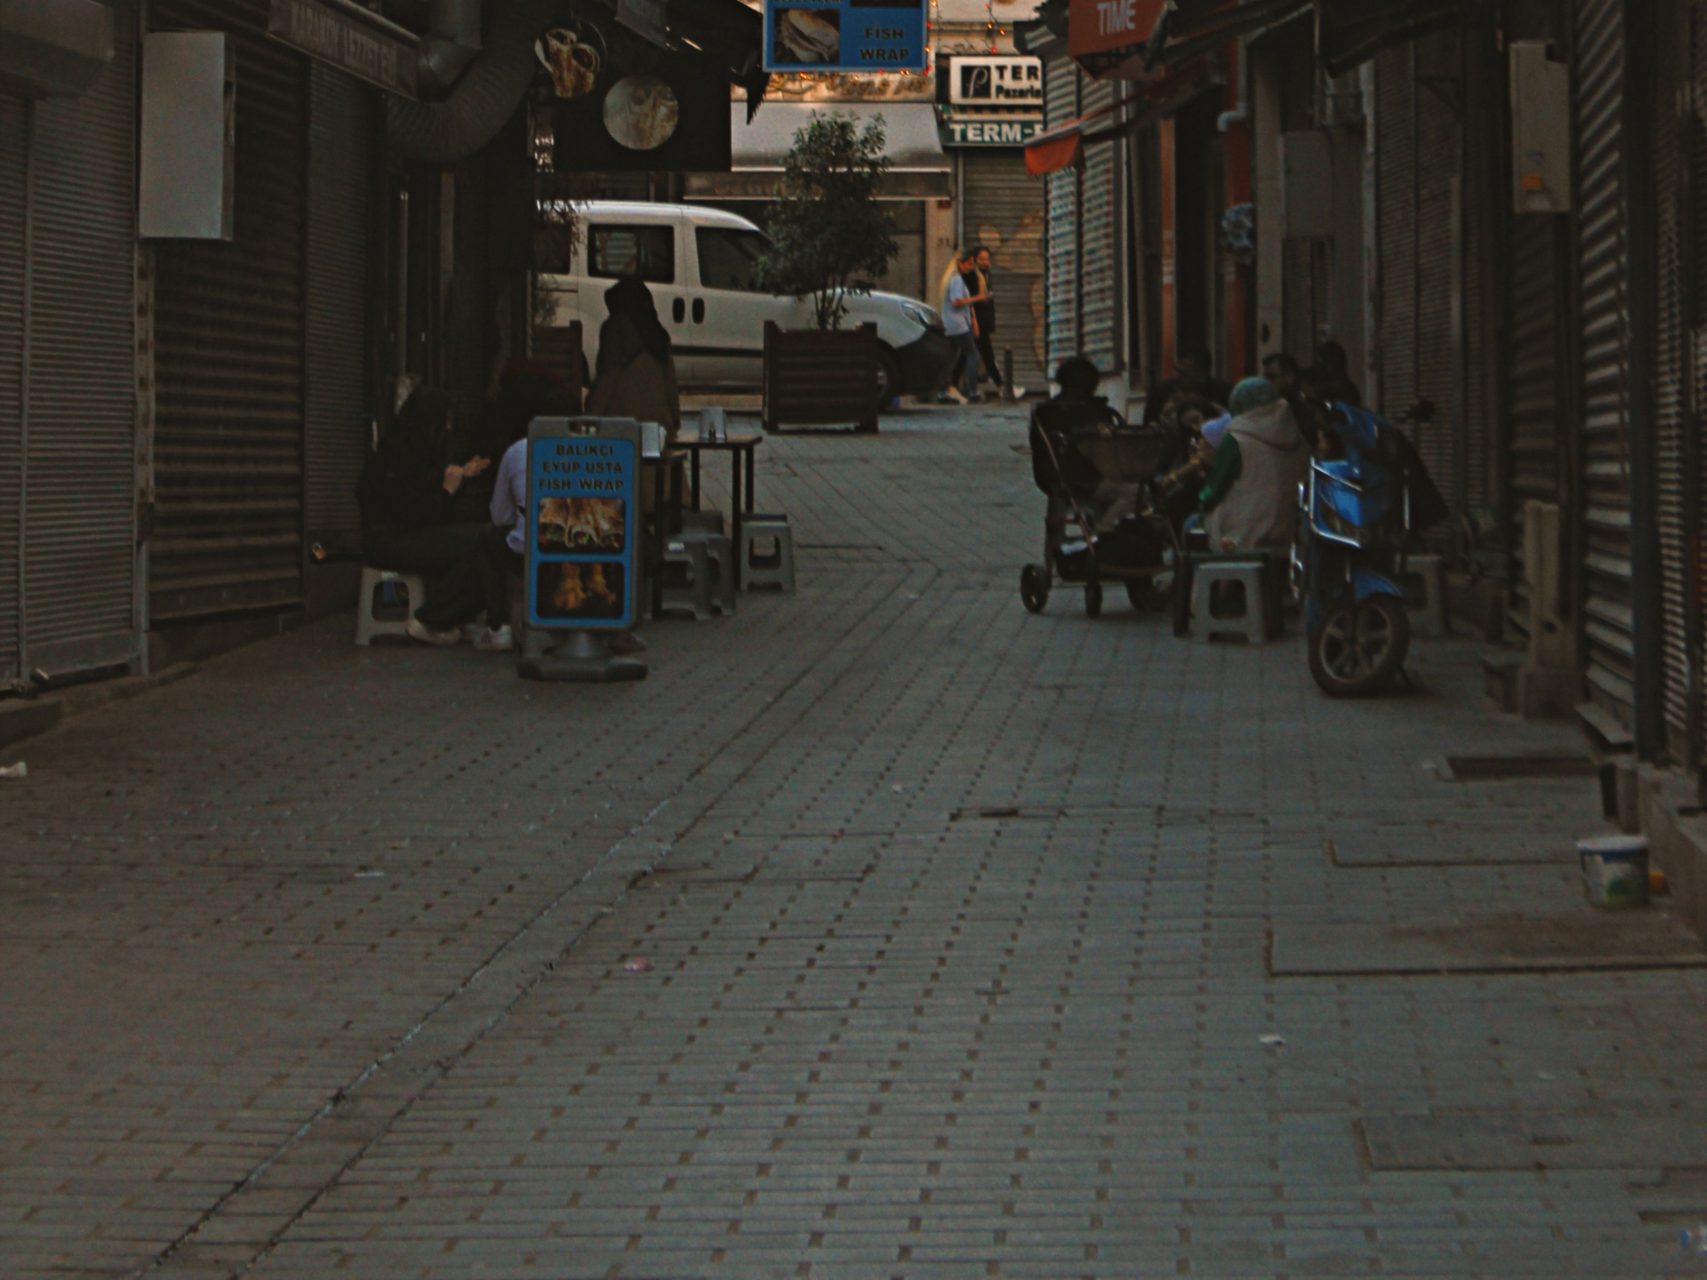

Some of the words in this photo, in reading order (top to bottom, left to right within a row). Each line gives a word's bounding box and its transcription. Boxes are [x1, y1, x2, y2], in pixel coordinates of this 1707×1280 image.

[860, 48, 910, 61] WRAP
[585, 462, 622, 473] USTA
[579, 479, 624, 490] WRAP
